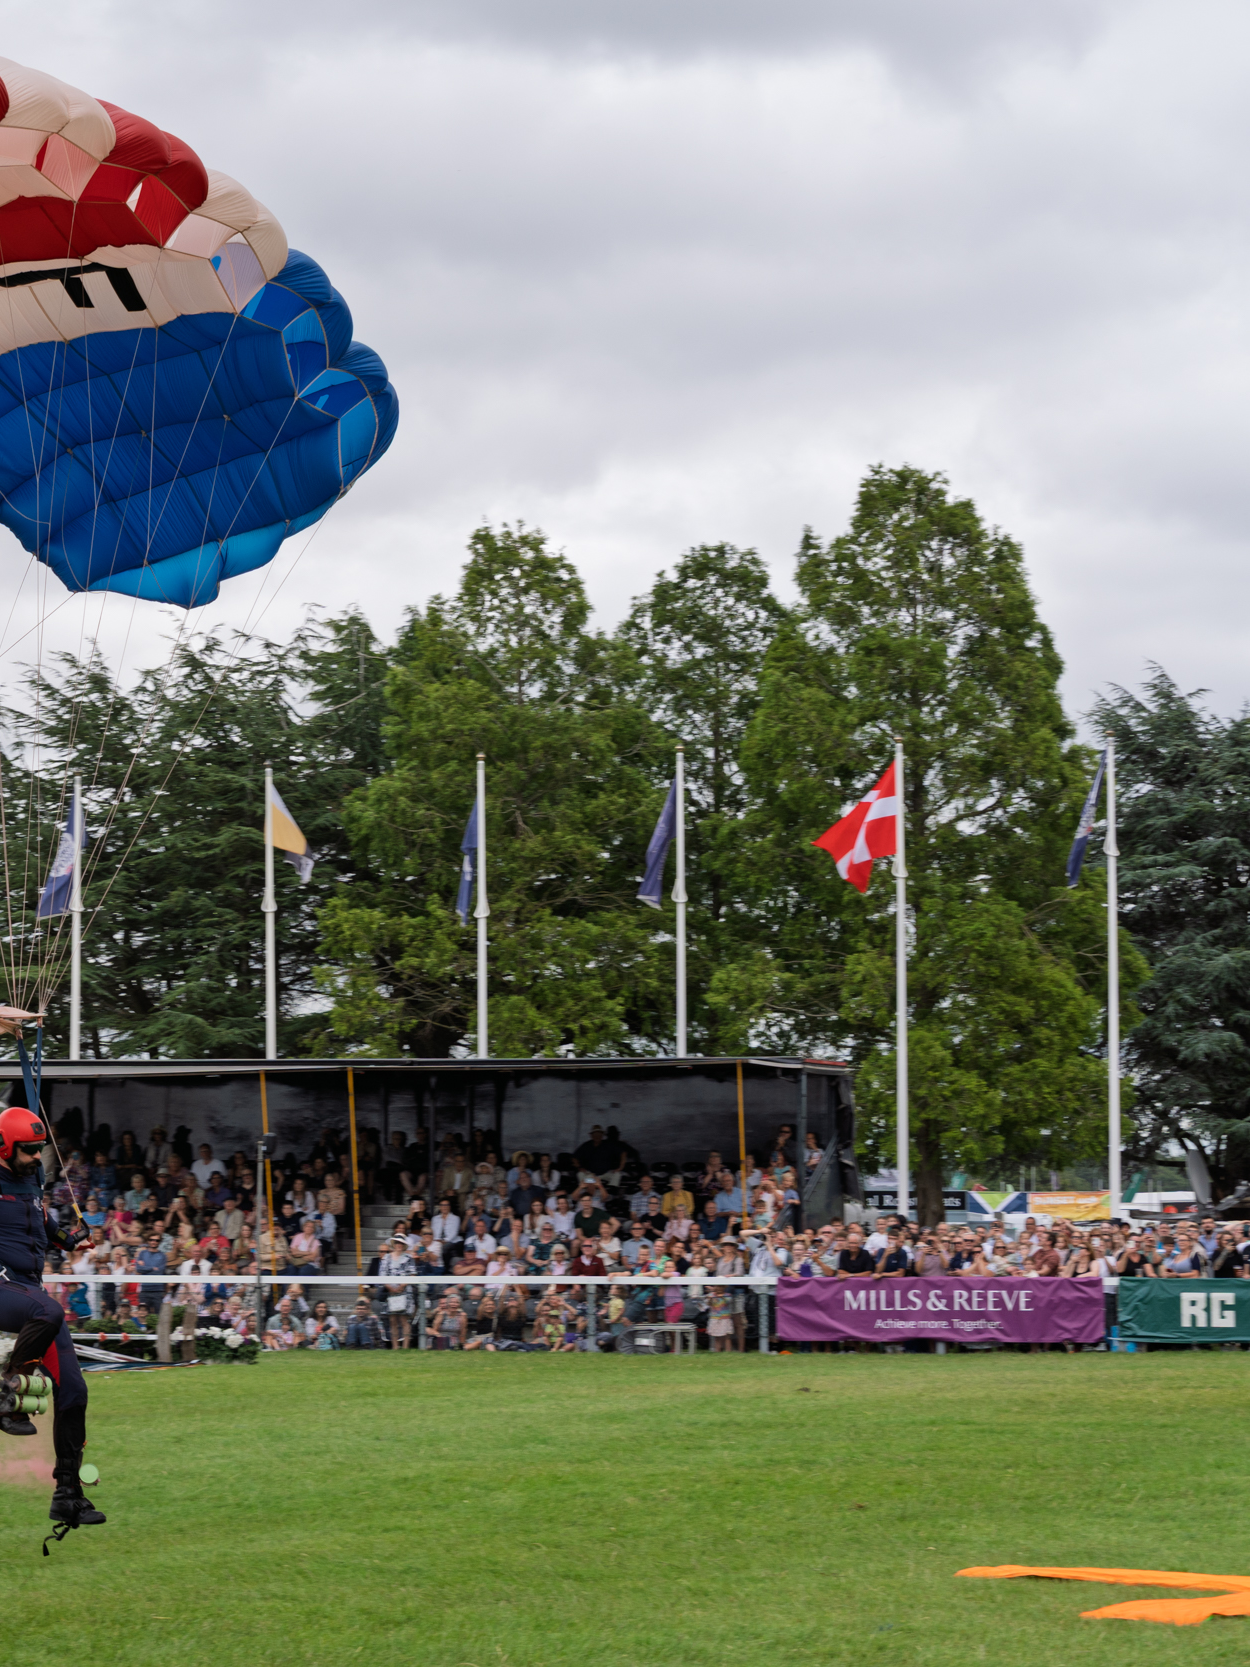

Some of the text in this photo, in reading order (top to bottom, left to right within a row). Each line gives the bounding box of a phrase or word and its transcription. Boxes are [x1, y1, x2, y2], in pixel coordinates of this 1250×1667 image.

[843, 1289, 1035, 1311] MILLS & REEVE
[1181, 1292, 1236, 1327] RG
[874, 1318, 1005, 1332] Achieve more. Together.
